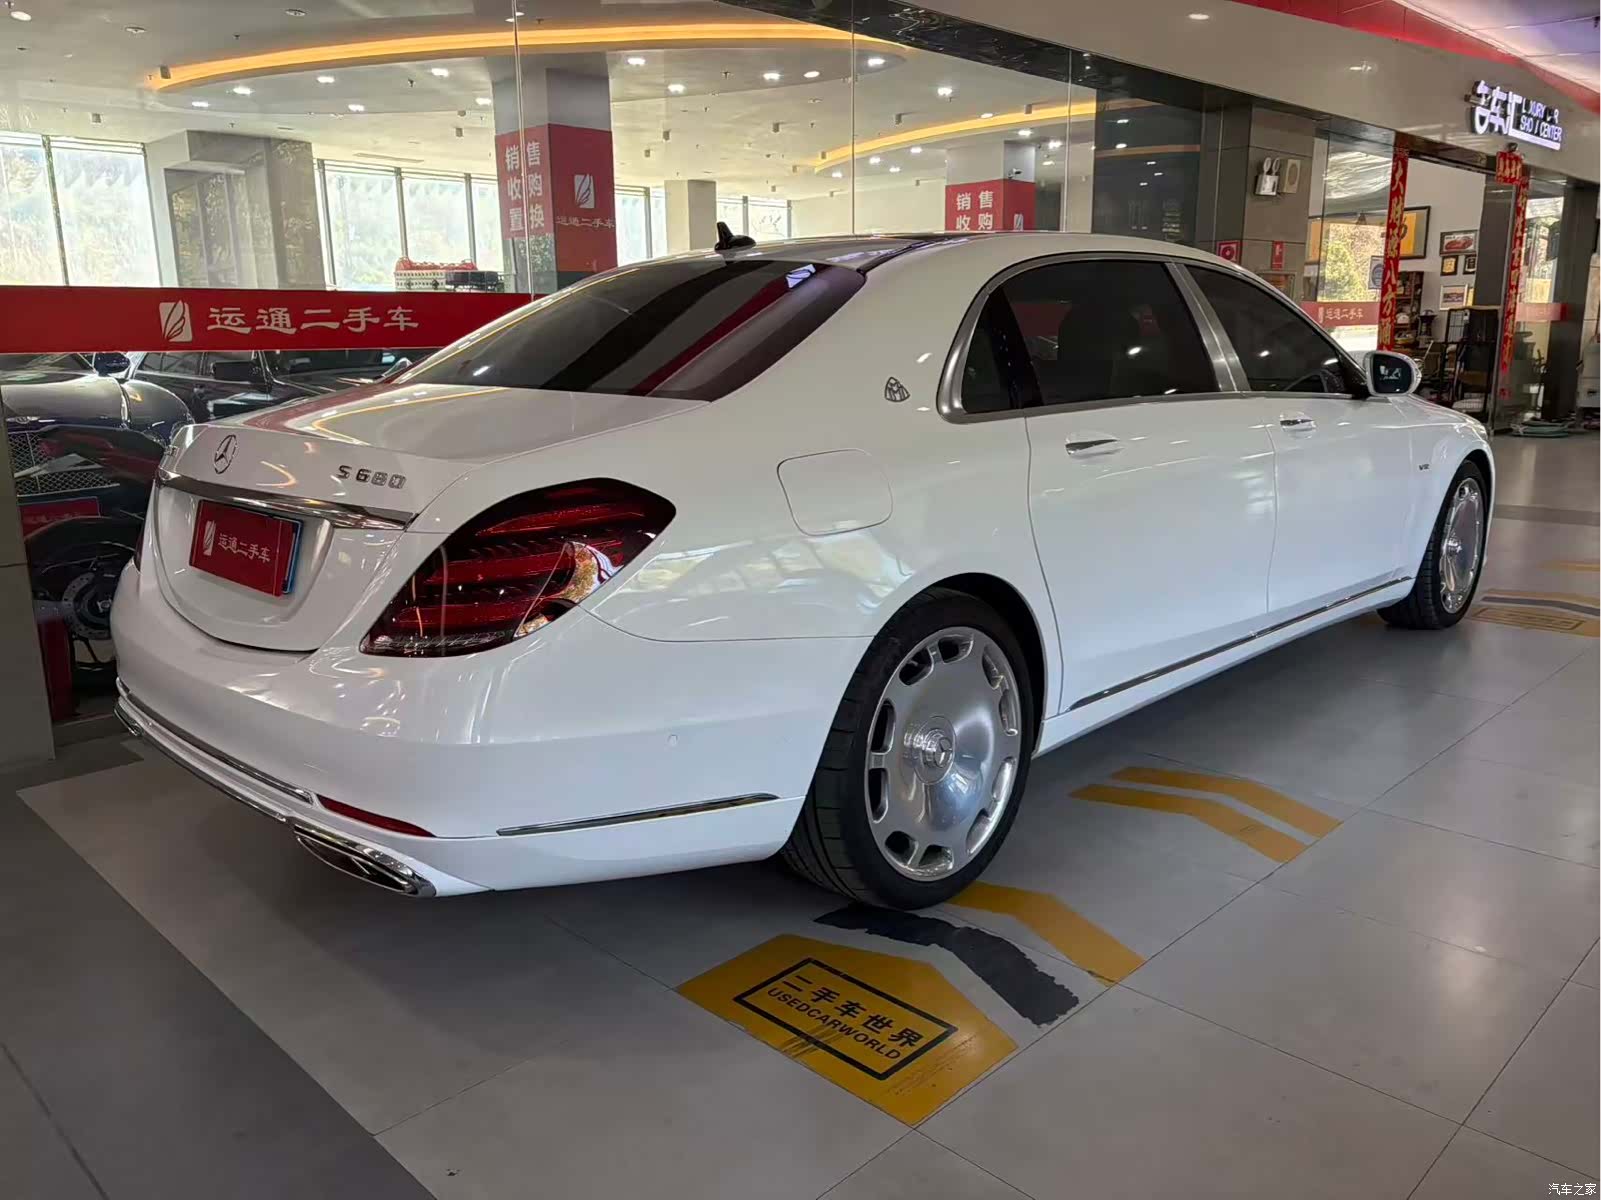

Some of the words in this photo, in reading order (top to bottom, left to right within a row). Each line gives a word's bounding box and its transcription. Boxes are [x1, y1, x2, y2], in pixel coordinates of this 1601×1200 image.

[1522, 98, 1547, 119] LXURY
[1520, 115, 1540, 134] SHO
[1540, 121, 1562, 142] CENTER
[956, 190, 994, 212] 销售
[956, 212, 994, 231] 收购
[206, 305, 419, 335] 运通二手车
[336, 464, 353, 480] S
[356, 468, 407, 490] 680
[217, 532, 272, 564] 运通二手车
[767, 987, 902, 1061] USEDCARWORLD
[782, 975, 924, 1048] 二手车世界
